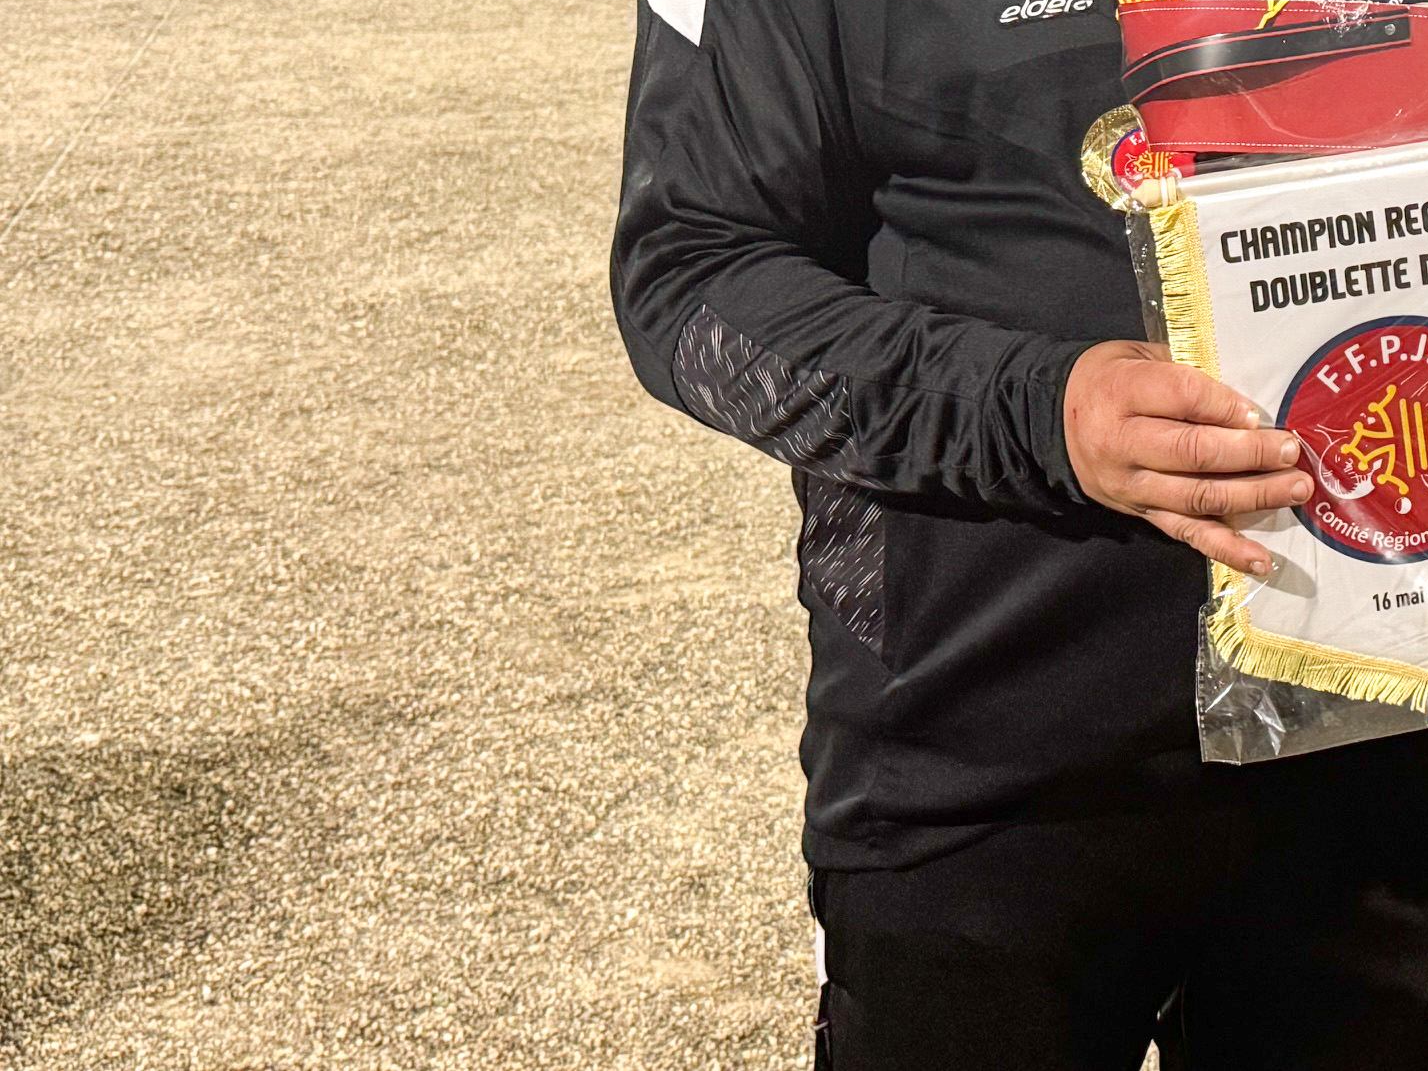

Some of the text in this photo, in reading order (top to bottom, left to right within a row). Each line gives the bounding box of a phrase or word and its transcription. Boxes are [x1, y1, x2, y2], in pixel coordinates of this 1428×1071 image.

[1220, 210, 1377, 264] CHAMPION
[1250, 257, 1412, 313] DOUBLETTE
[1315, 501, 1370, 544] Comité
[1372, 591, 1392, 612] 16
[1395, 586, 1425, 608] mai
